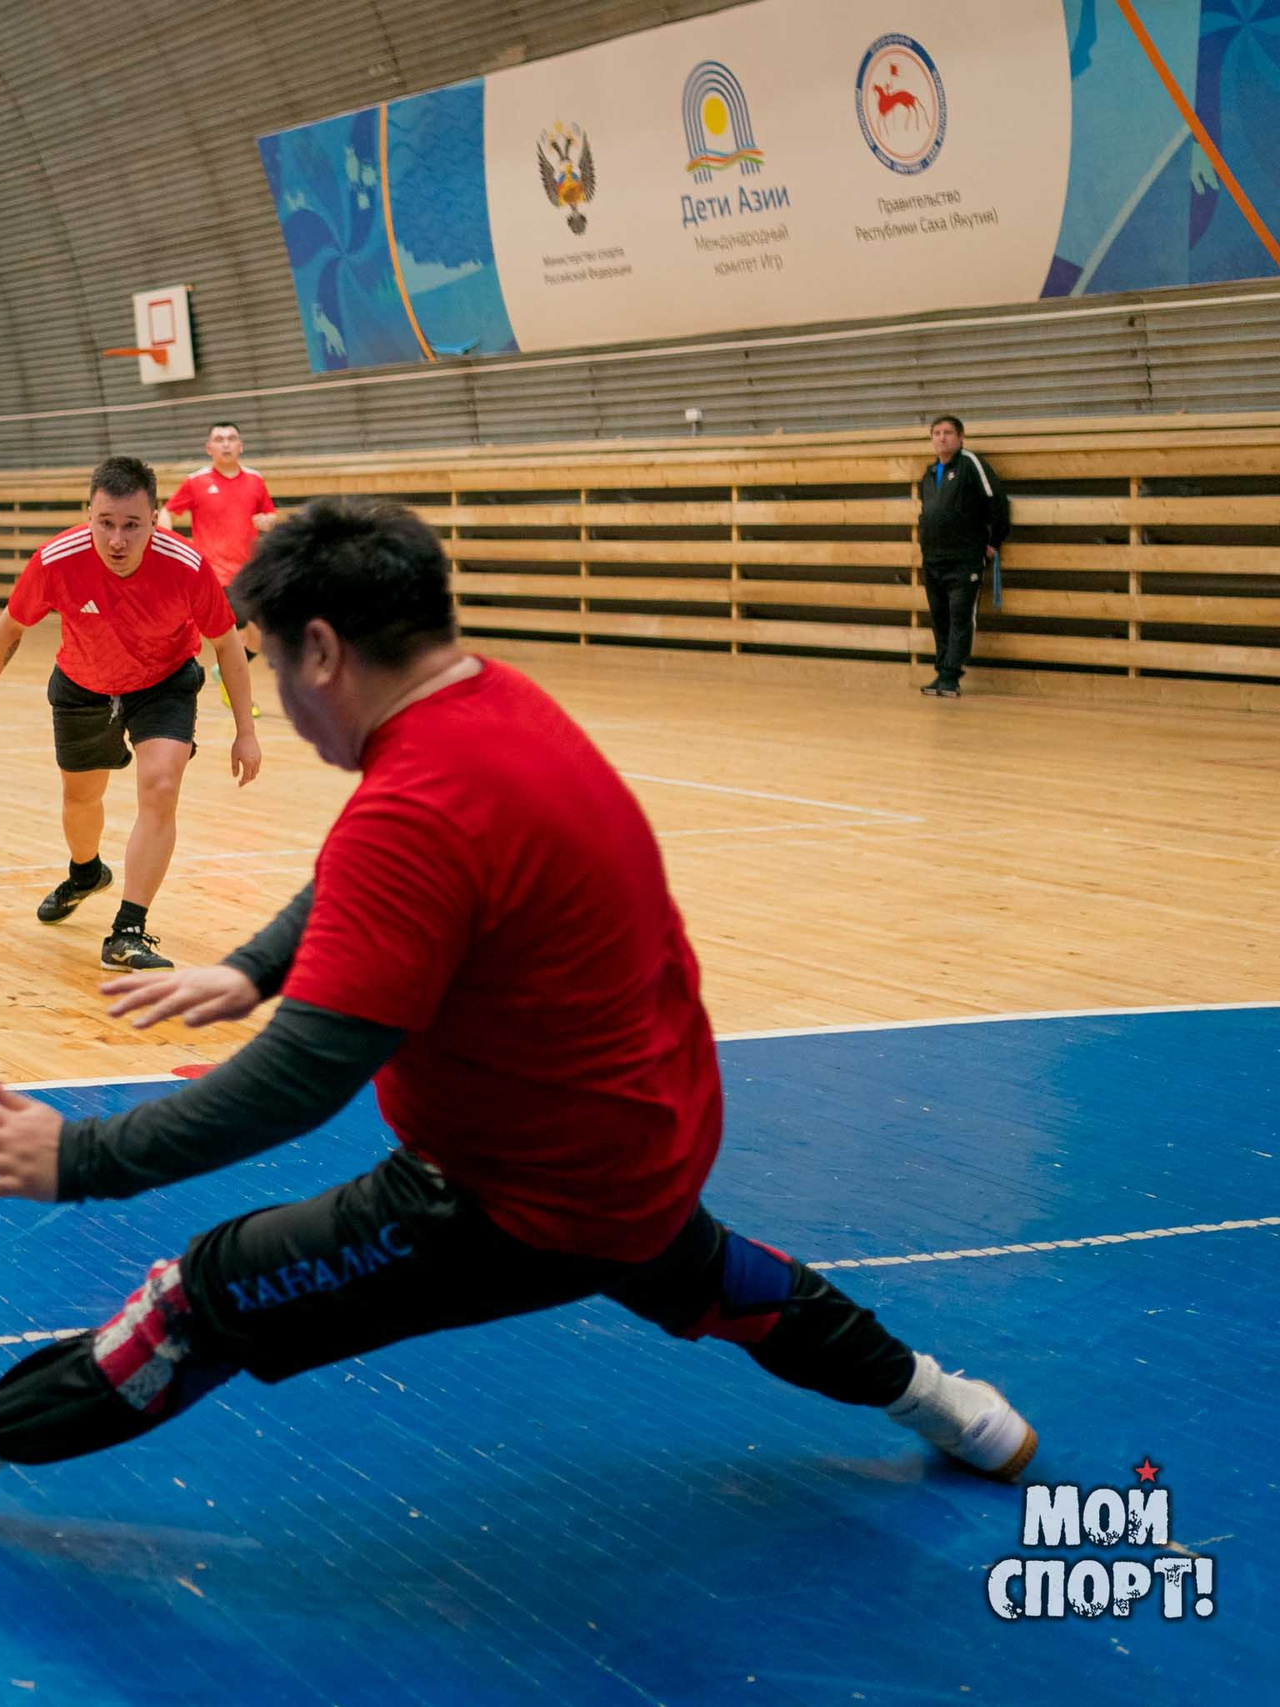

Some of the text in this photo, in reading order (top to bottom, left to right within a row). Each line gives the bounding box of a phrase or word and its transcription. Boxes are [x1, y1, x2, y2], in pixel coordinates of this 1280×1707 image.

[681, 184, 791, 229] Дети Азии
[878, 190, 961, 215] Правительство
[855, 207, 999, 242] Республики Саха (Якутия)
